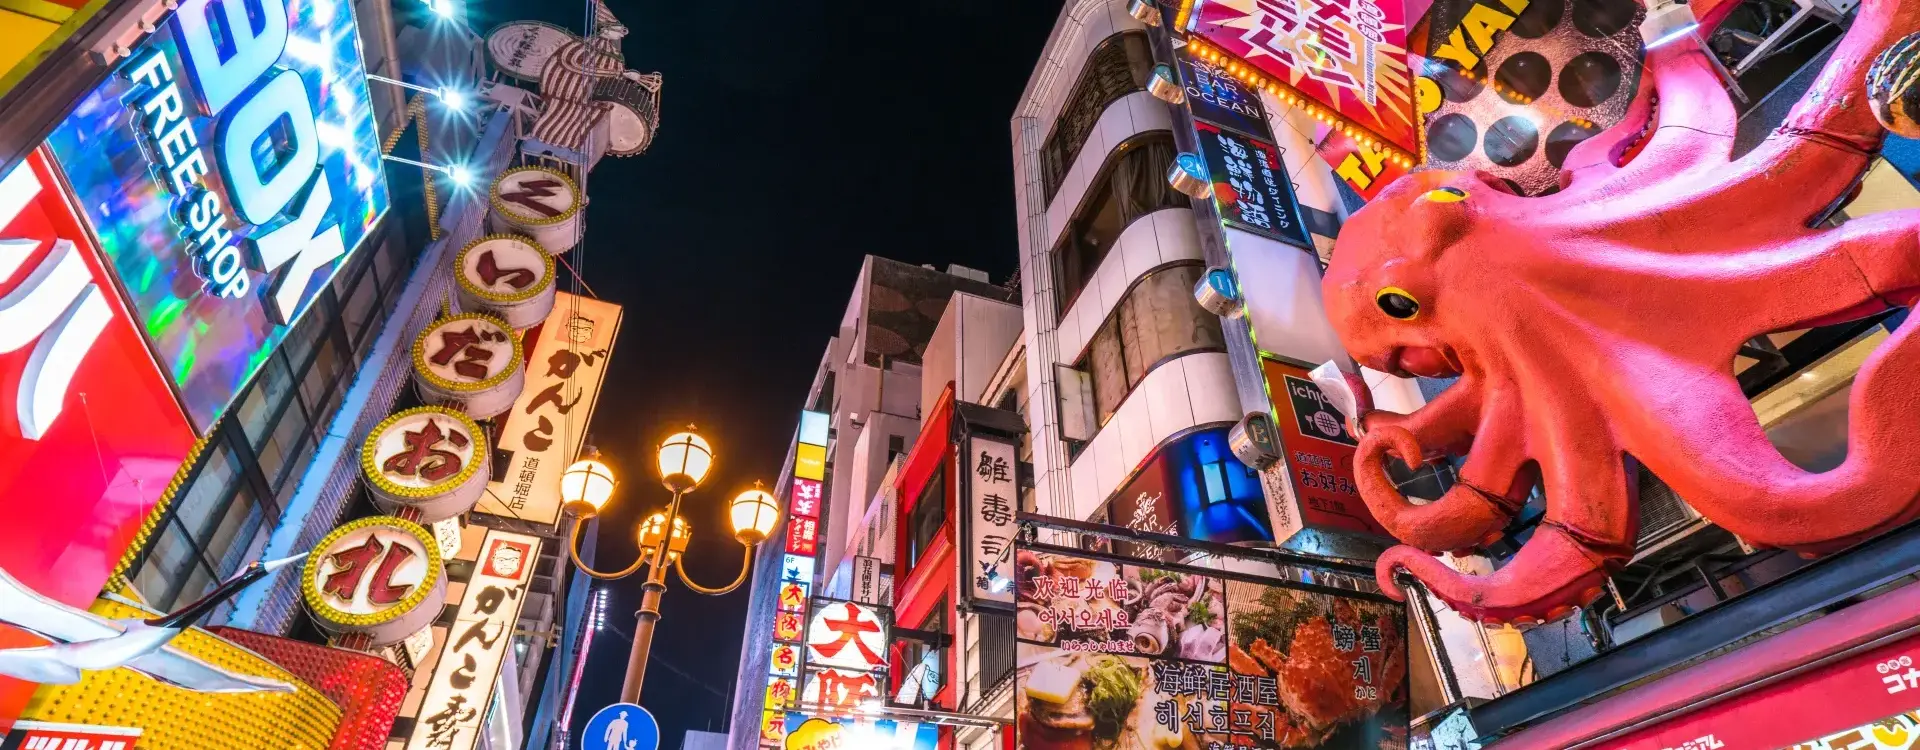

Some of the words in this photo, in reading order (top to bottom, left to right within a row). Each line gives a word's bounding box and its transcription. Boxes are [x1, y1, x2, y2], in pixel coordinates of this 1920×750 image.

[1197, 72, 1239, 97] BAR
[1186, 87, 1262, 119] OCEAN
[131, 49, 208, 197] FREE
[189, 191, 251, 299] SHOP
[522, 349, 607, 452] がんこ
[508, 456, 541, 511] 道頓堀店
[785, 557, 795, 568] 6F
[1032, 576, 1129, 600] 欢迎光临
[1038, 607, 1132, 632] 어서오세요
[1061, 639, 1135, 652] いらっしゃいませ
[1355, 686, 1378, 700] かに
[1154, 698, 1277, 741] 해선호프집
